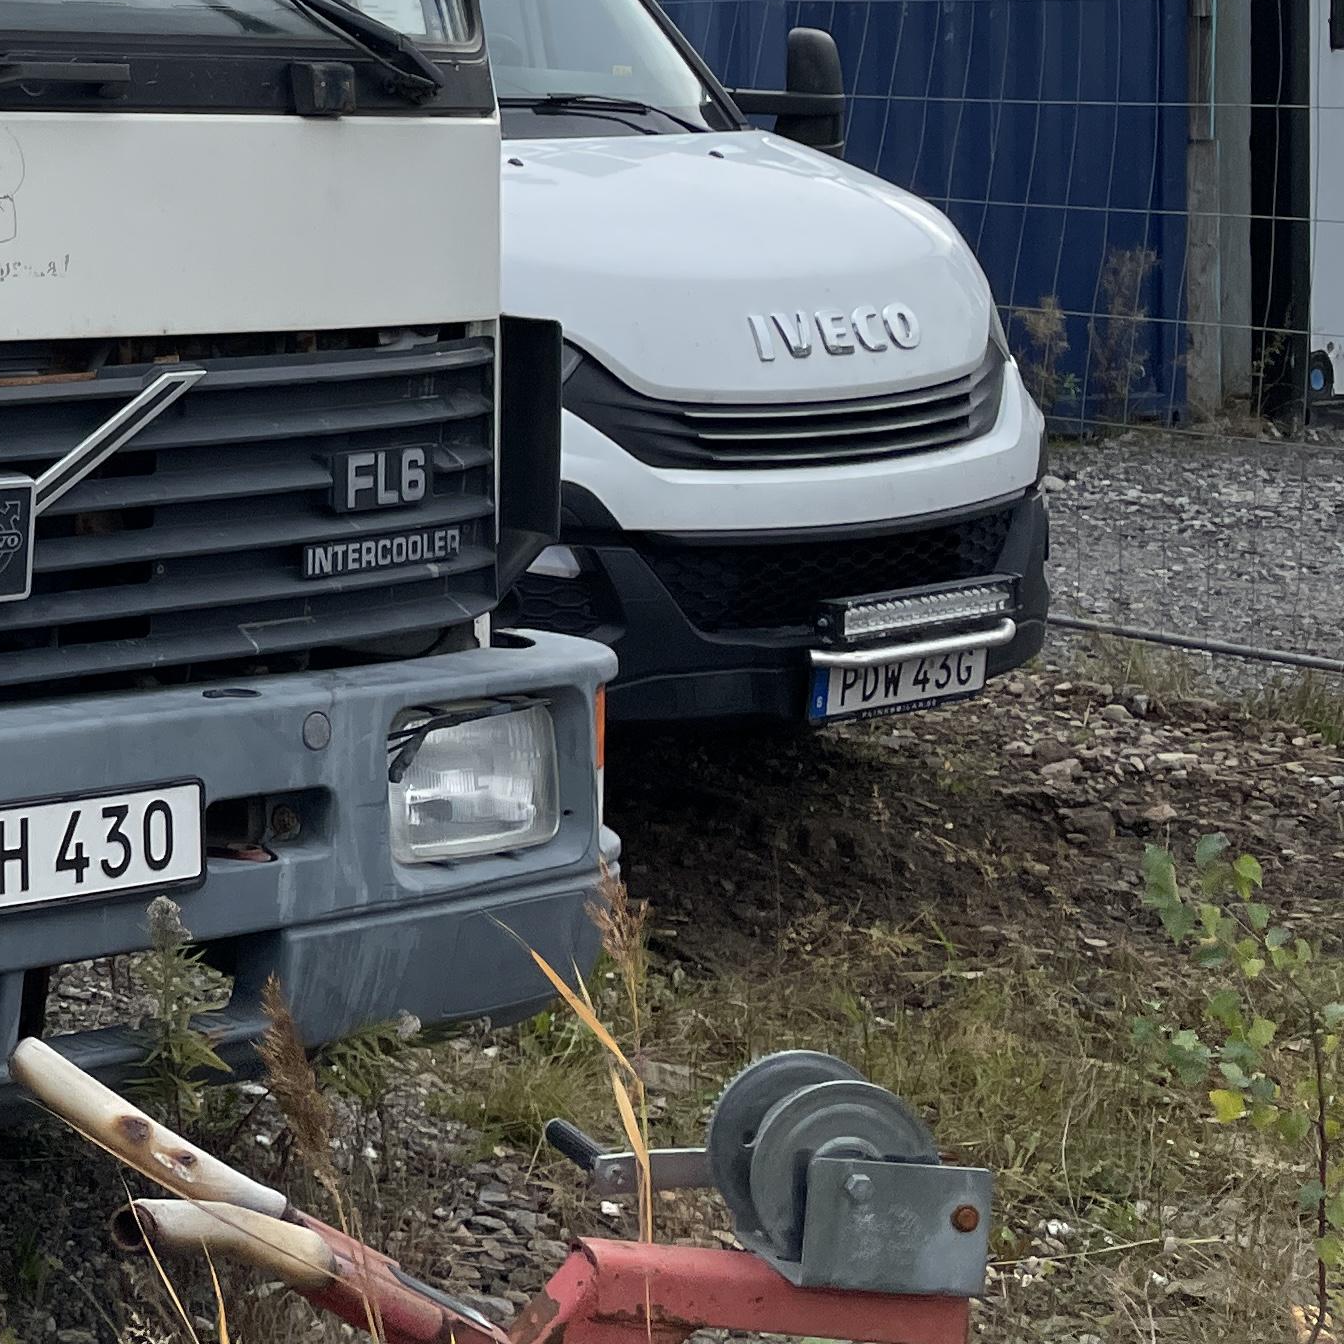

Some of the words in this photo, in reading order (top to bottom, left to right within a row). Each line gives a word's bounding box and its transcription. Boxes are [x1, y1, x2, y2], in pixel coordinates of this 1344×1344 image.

[747, 302, 921, 362] IVECO
[347, 447, 426, 508] FL6
[307, 528, 460, 576] INTERCOOLER
[837, 662, 902, 706] PDW
[56, 799, 173, 884] 430
